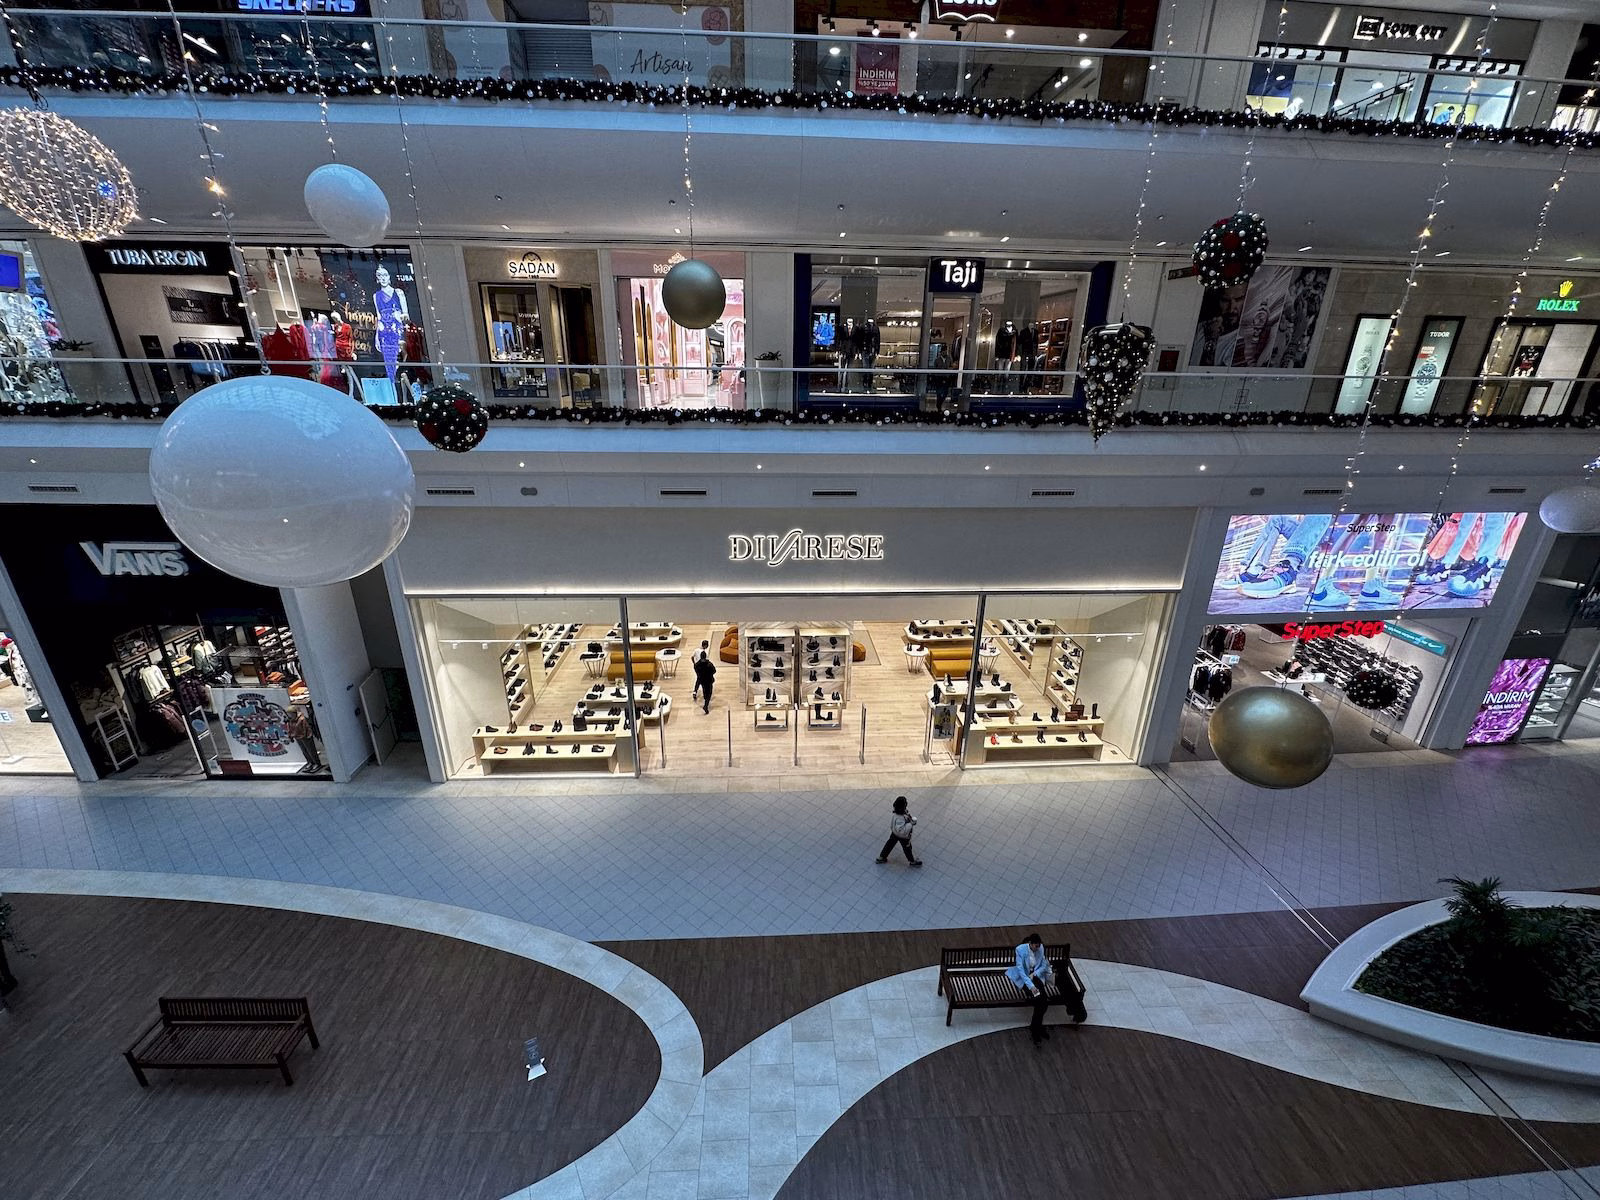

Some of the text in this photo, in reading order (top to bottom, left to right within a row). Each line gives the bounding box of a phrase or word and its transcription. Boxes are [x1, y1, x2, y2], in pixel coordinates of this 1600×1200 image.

[630, 49, 694, 75] Artisan
[859, 67, 896, 79] İNDİRİM
[104, 249, 207, 267] TUBA ERGIN
[508, 261, 556, 275] ŞADAN
[940, 260, 977, 288] Taji
[1536, 299, 1581, 312] ROLEX
[729, 528, 885, 567] DIVARESE
[79, 541, 189, 577] VANS
[1282, 620, 1385, 643] SuperStep
[1482, 688, 1536, 705] İNDİRİM
